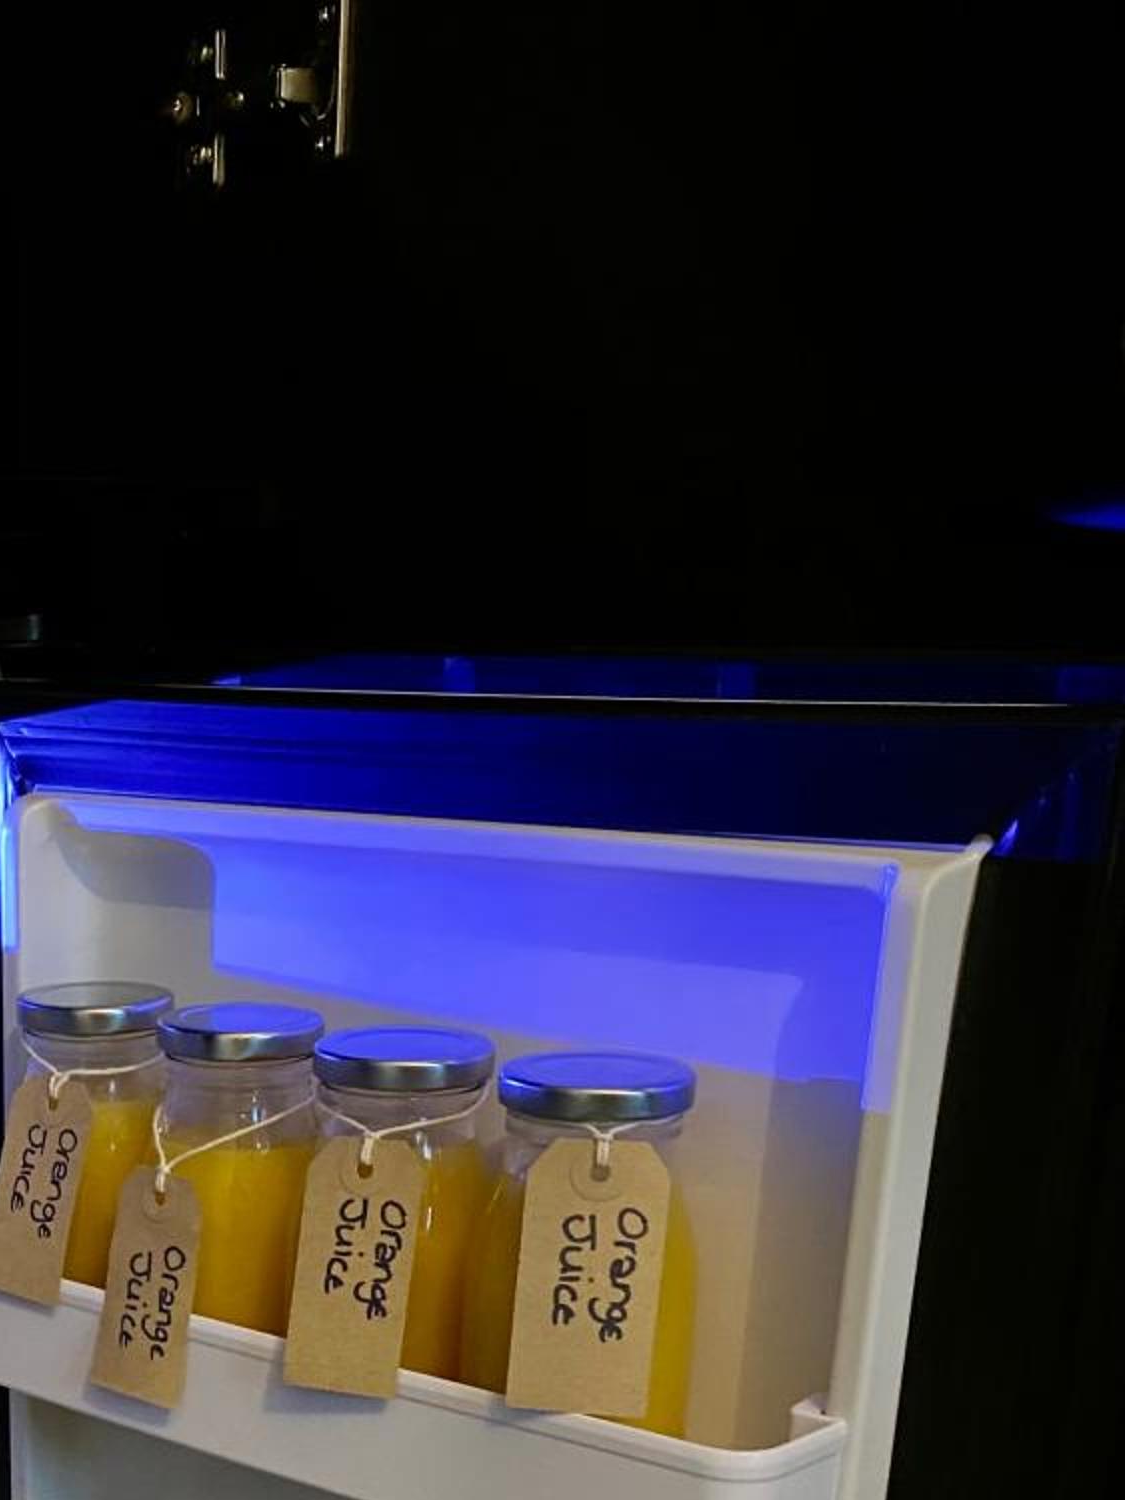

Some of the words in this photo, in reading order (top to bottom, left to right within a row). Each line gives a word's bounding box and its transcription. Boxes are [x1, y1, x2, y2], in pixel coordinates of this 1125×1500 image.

[10, 1123, 48, 1213] Juice
[30, 1128, 79, 1239] Orange
[119, 1251, 153, 1349] Juice
[323, 1198, 369, 1295] Juice
[352, 1199, 408, 1321] Orange
[551, 1213, 598, 1327] Juice
[586, 1206, 650, 1344] Orange
[141, 1245, 187, 1361] Orange
